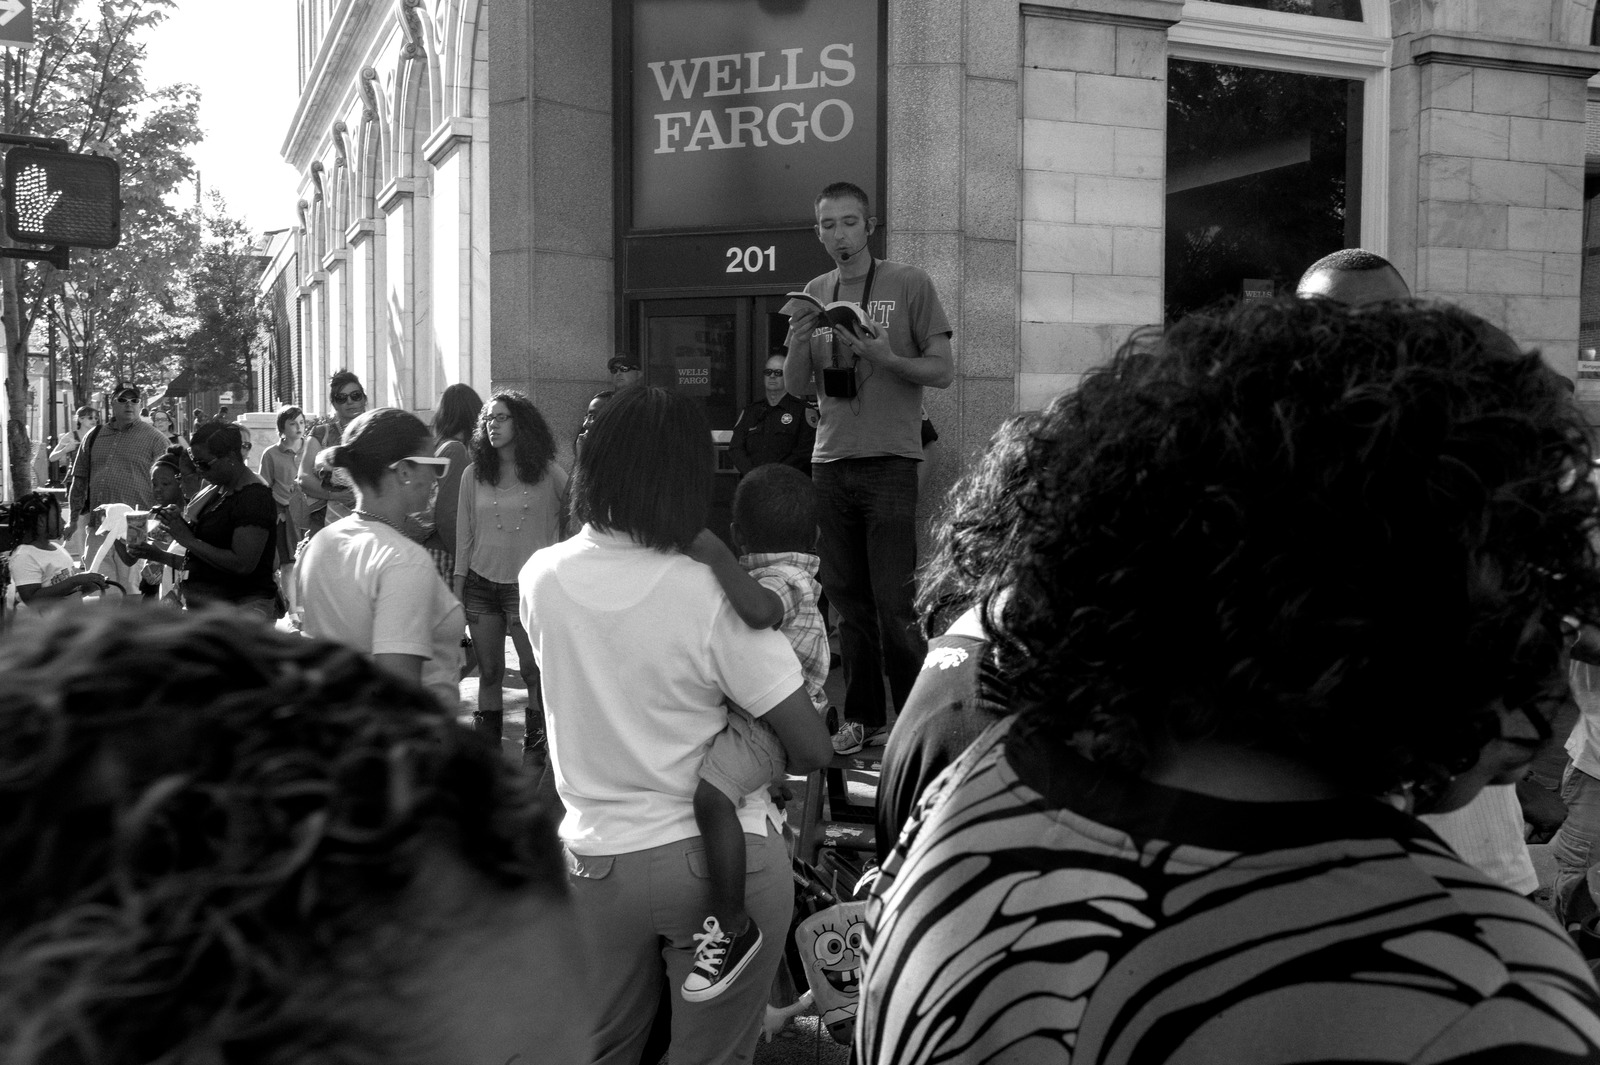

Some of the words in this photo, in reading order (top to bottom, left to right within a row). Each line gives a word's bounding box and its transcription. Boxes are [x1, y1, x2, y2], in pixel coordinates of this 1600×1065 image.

[647, 43, 856, 101] WELLS
[654, 98, 854, 154] FARGO
[726, 246, 776, 273] 201
[1244, 290, 1272, 298] WELLS
[678, 368, 709, 376] WELLS
[678, 377, 709, 385] FARGO
